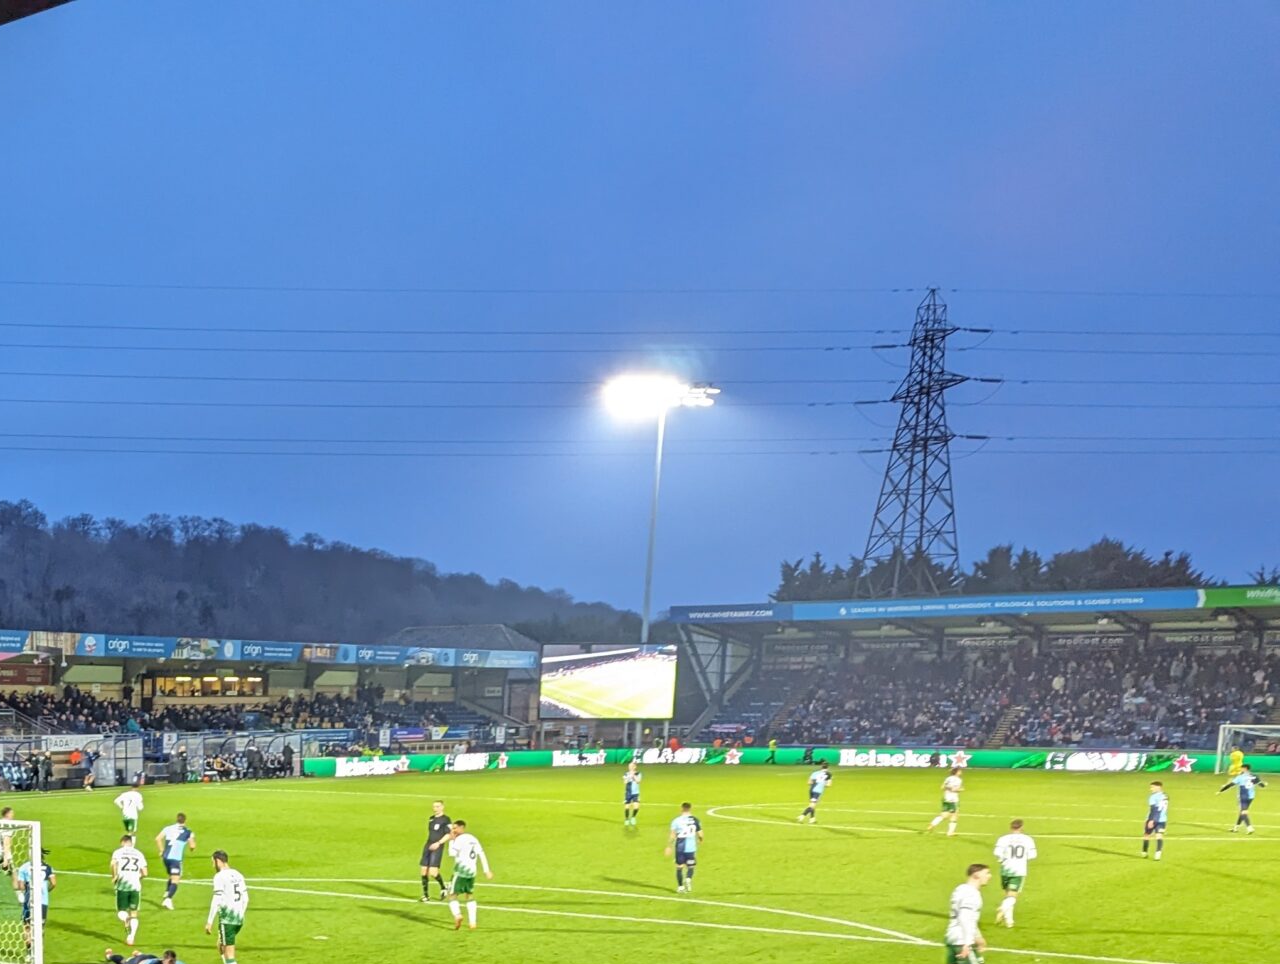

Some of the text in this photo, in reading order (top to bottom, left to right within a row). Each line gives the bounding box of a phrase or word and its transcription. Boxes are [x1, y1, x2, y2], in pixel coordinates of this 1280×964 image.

[1008, 844, 1025, 859] 10
[121, 857, 139, 872] 23
[234, 884, 241, 902] 5
